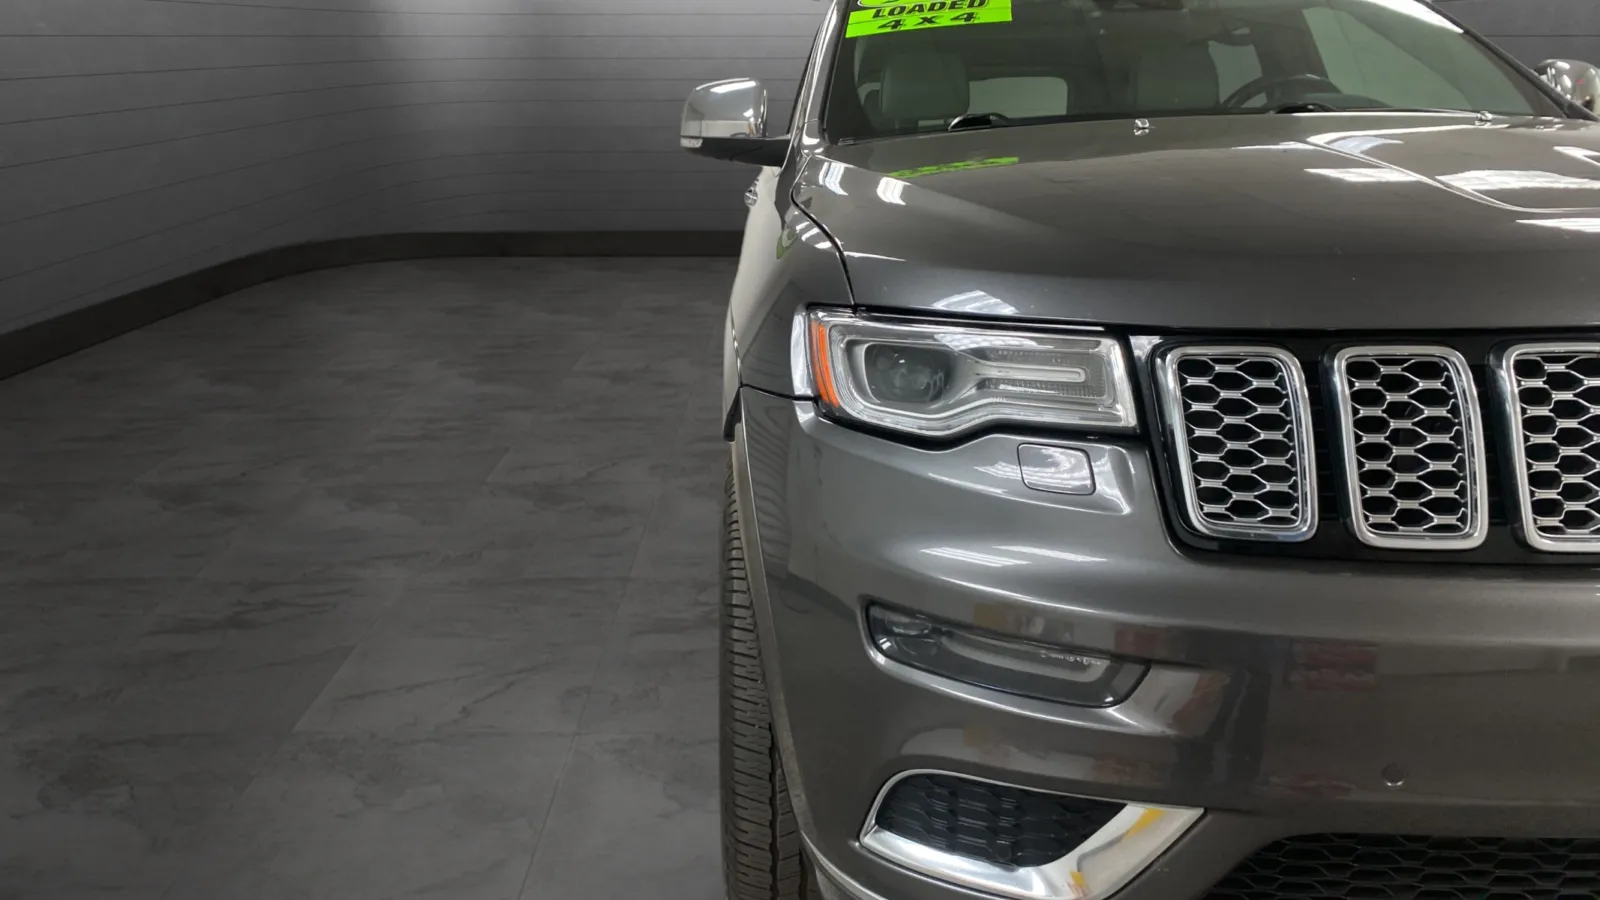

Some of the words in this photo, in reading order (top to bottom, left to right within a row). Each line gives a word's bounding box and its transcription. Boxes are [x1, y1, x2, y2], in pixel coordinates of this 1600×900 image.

[872, 0, 988, 18] LOADED
[877, 18, 904, 30] 4
[950, 11, 977, 23] 4
